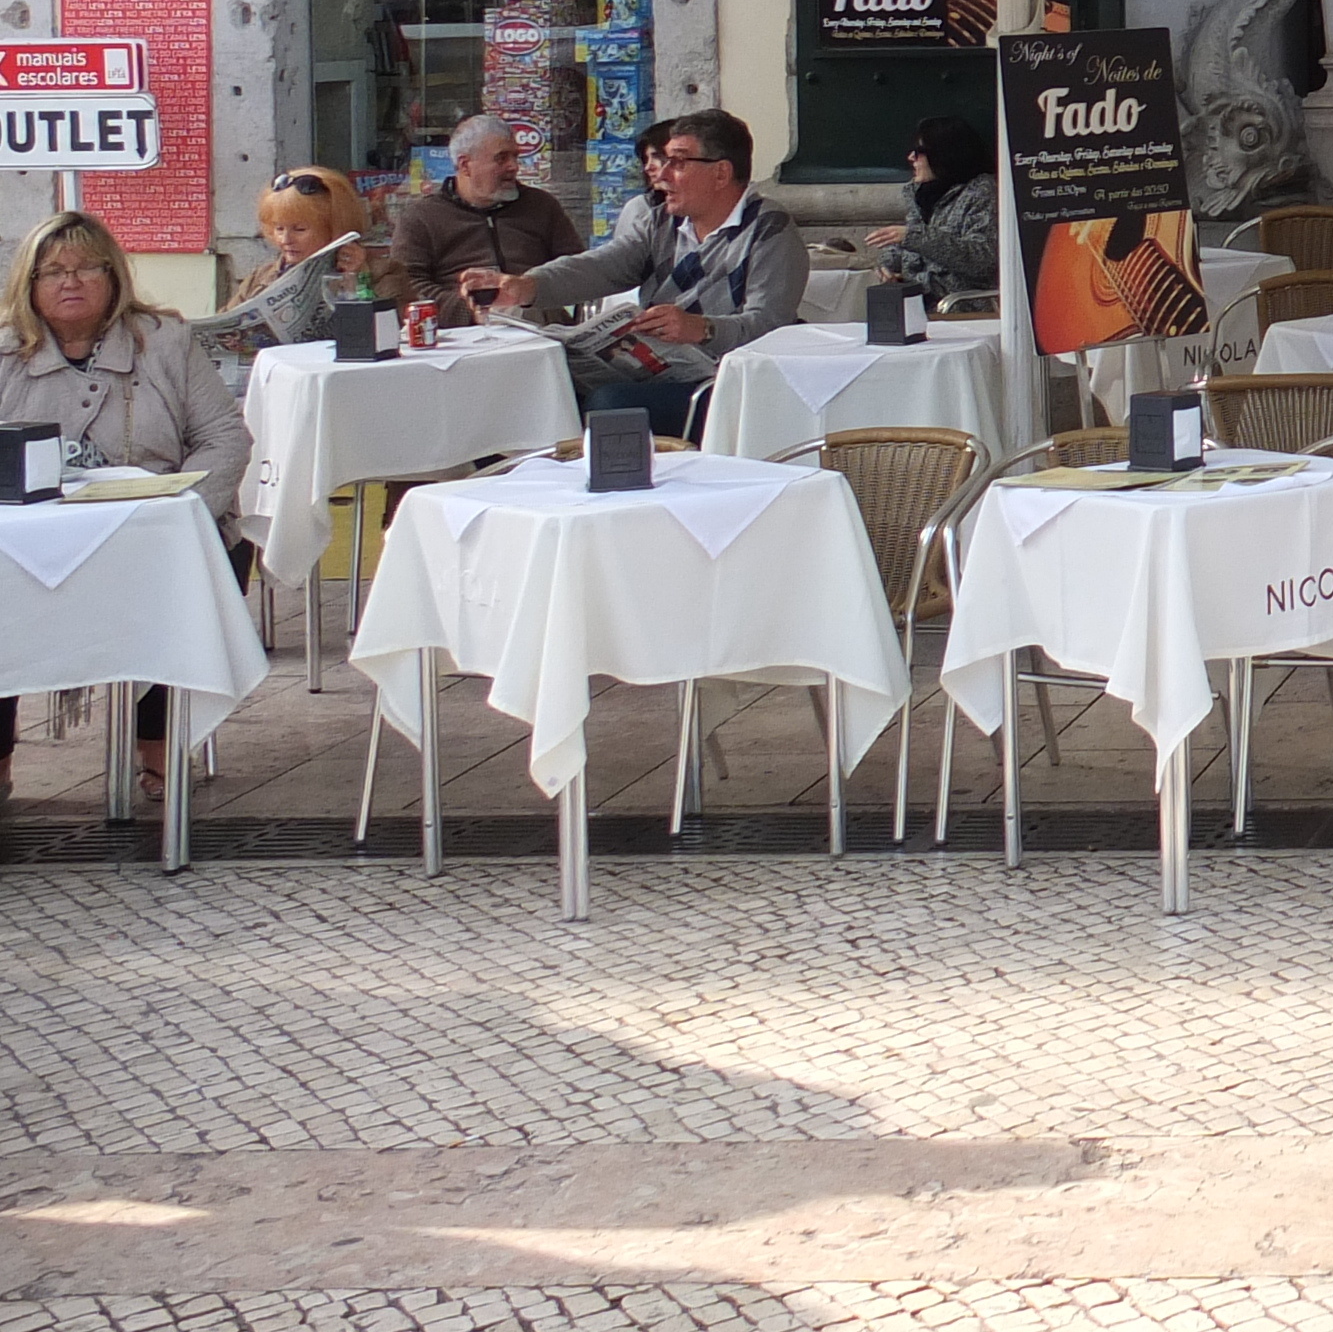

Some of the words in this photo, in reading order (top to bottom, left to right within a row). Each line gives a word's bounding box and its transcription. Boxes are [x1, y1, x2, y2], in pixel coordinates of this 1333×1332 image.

[495, 28, 539, 43] LOGO
[16, 47, 87, 66] manuais
[1009, 41, 1064, 70] Night's
[1067, 42, 1083, 65] of
[17, 68, 99, 86] escolares
[1083, 55, 1140, 85] Noites
[1143, 59, 1163, 81] de
[1037, 87, 1148, 138] Fado
[0, 110, 154, 155] UTLET
[515, 132, 540, 145] GO
[267, 283, 298, 307] Daily
[594, 309, 634, 335] TIMES
[1183, 337, 1257, 367] NIOLA
